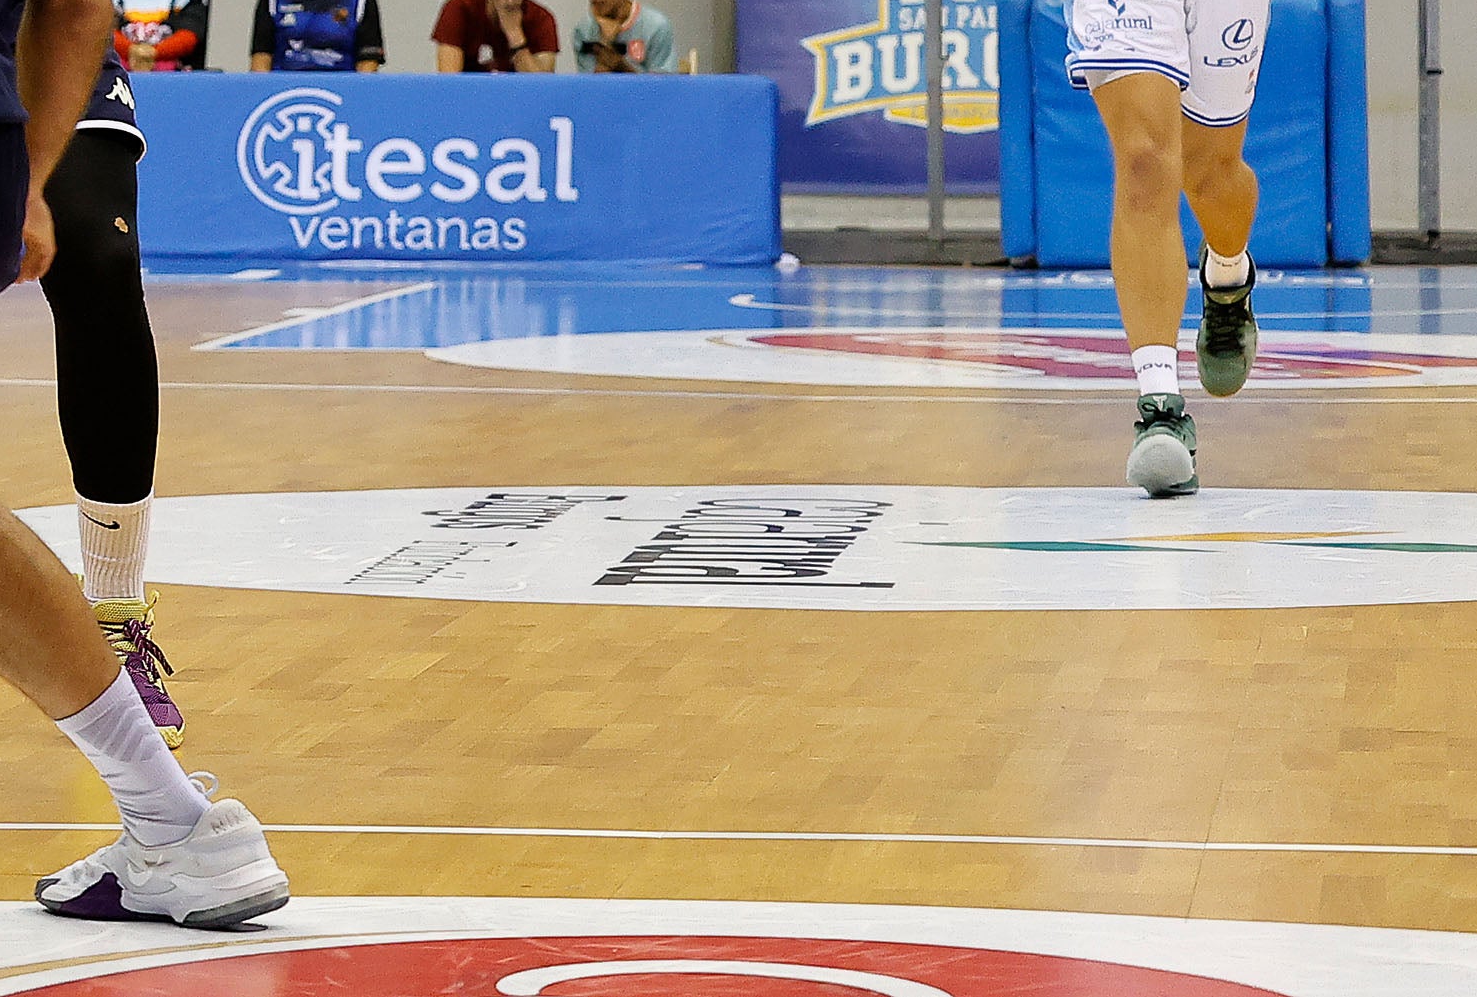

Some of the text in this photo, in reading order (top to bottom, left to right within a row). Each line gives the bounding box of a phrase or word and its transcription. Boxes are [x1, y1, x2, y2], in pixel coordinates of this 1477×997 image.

[1084, 15, 1153, 35] cajarural
[1203, 46, 1259, 67] LEXUS
[291, 115, 580, 203] itesal
[288, 209, 527, 252] ventanas
